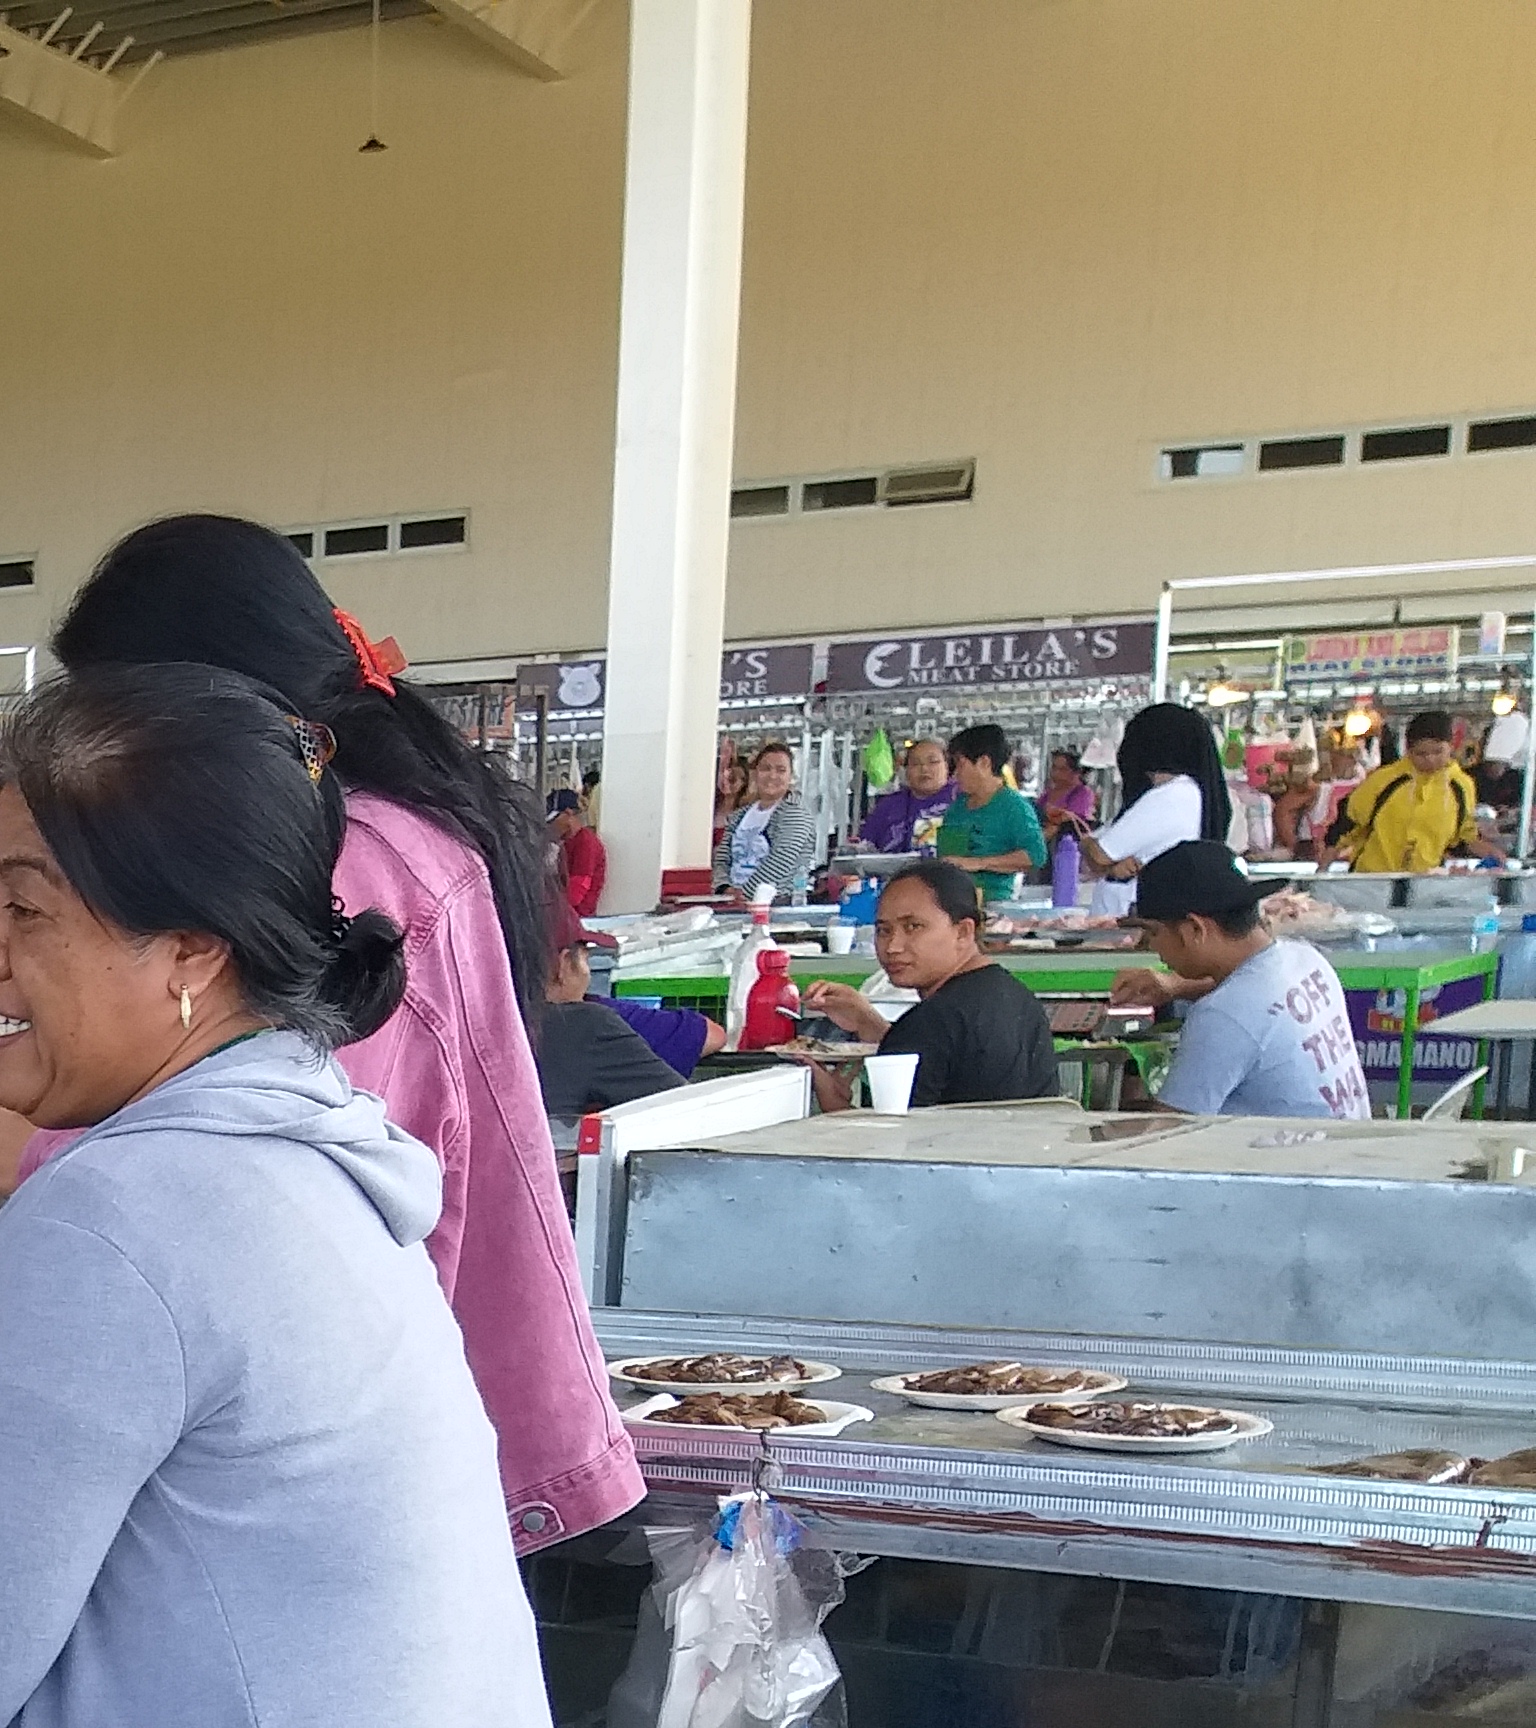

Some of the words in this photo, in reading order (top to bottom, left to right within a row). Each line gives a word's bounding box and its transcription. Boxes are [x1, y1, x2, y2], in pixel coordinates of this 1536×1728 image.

[907, 629, 1118, 670] LEILA'S
[720, 678, 768, 698] ORE
[907, 665, 978, 686] MEAT
[991, 659, 1079, 681] STORE
[1302, 1015, 1352, 1074] THE
